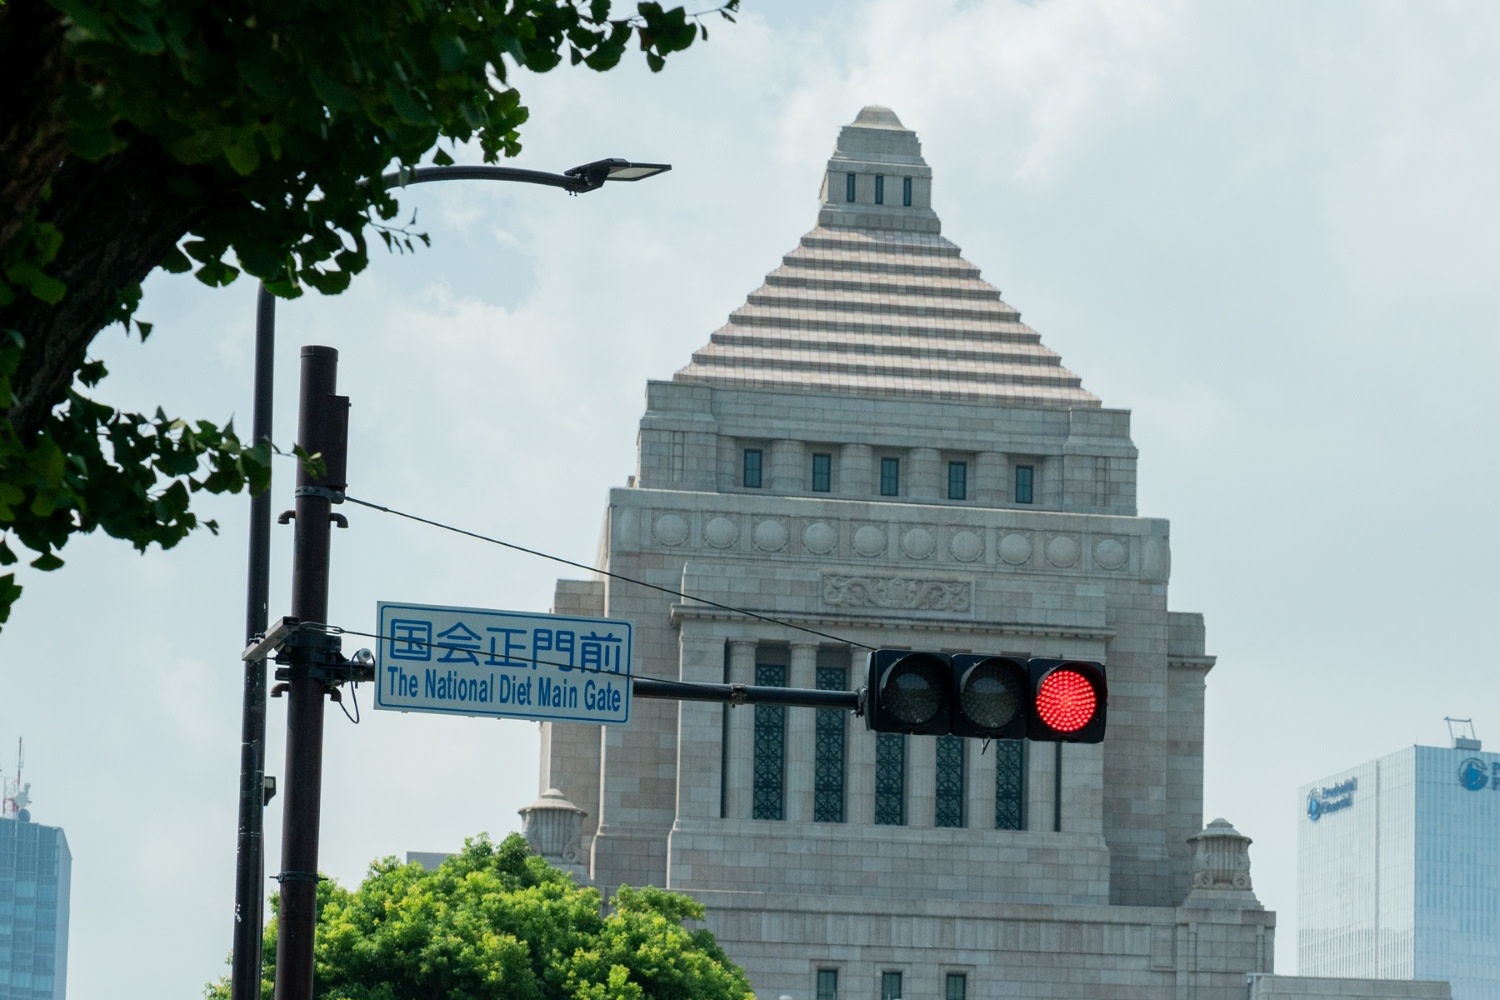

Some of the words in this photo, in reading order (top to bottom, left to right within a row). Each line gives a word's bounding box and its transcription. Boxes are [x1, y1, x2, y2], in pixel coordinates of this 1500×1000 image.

[390, 618, 623, 675] 国会正門前
[387, 666, 418, 698] The
[425, 669, 494, 703] National
[500, 674, 532, 706] Diet
[538, 677, 578, 709] Main
[584, 680, 621, 712] Gate
